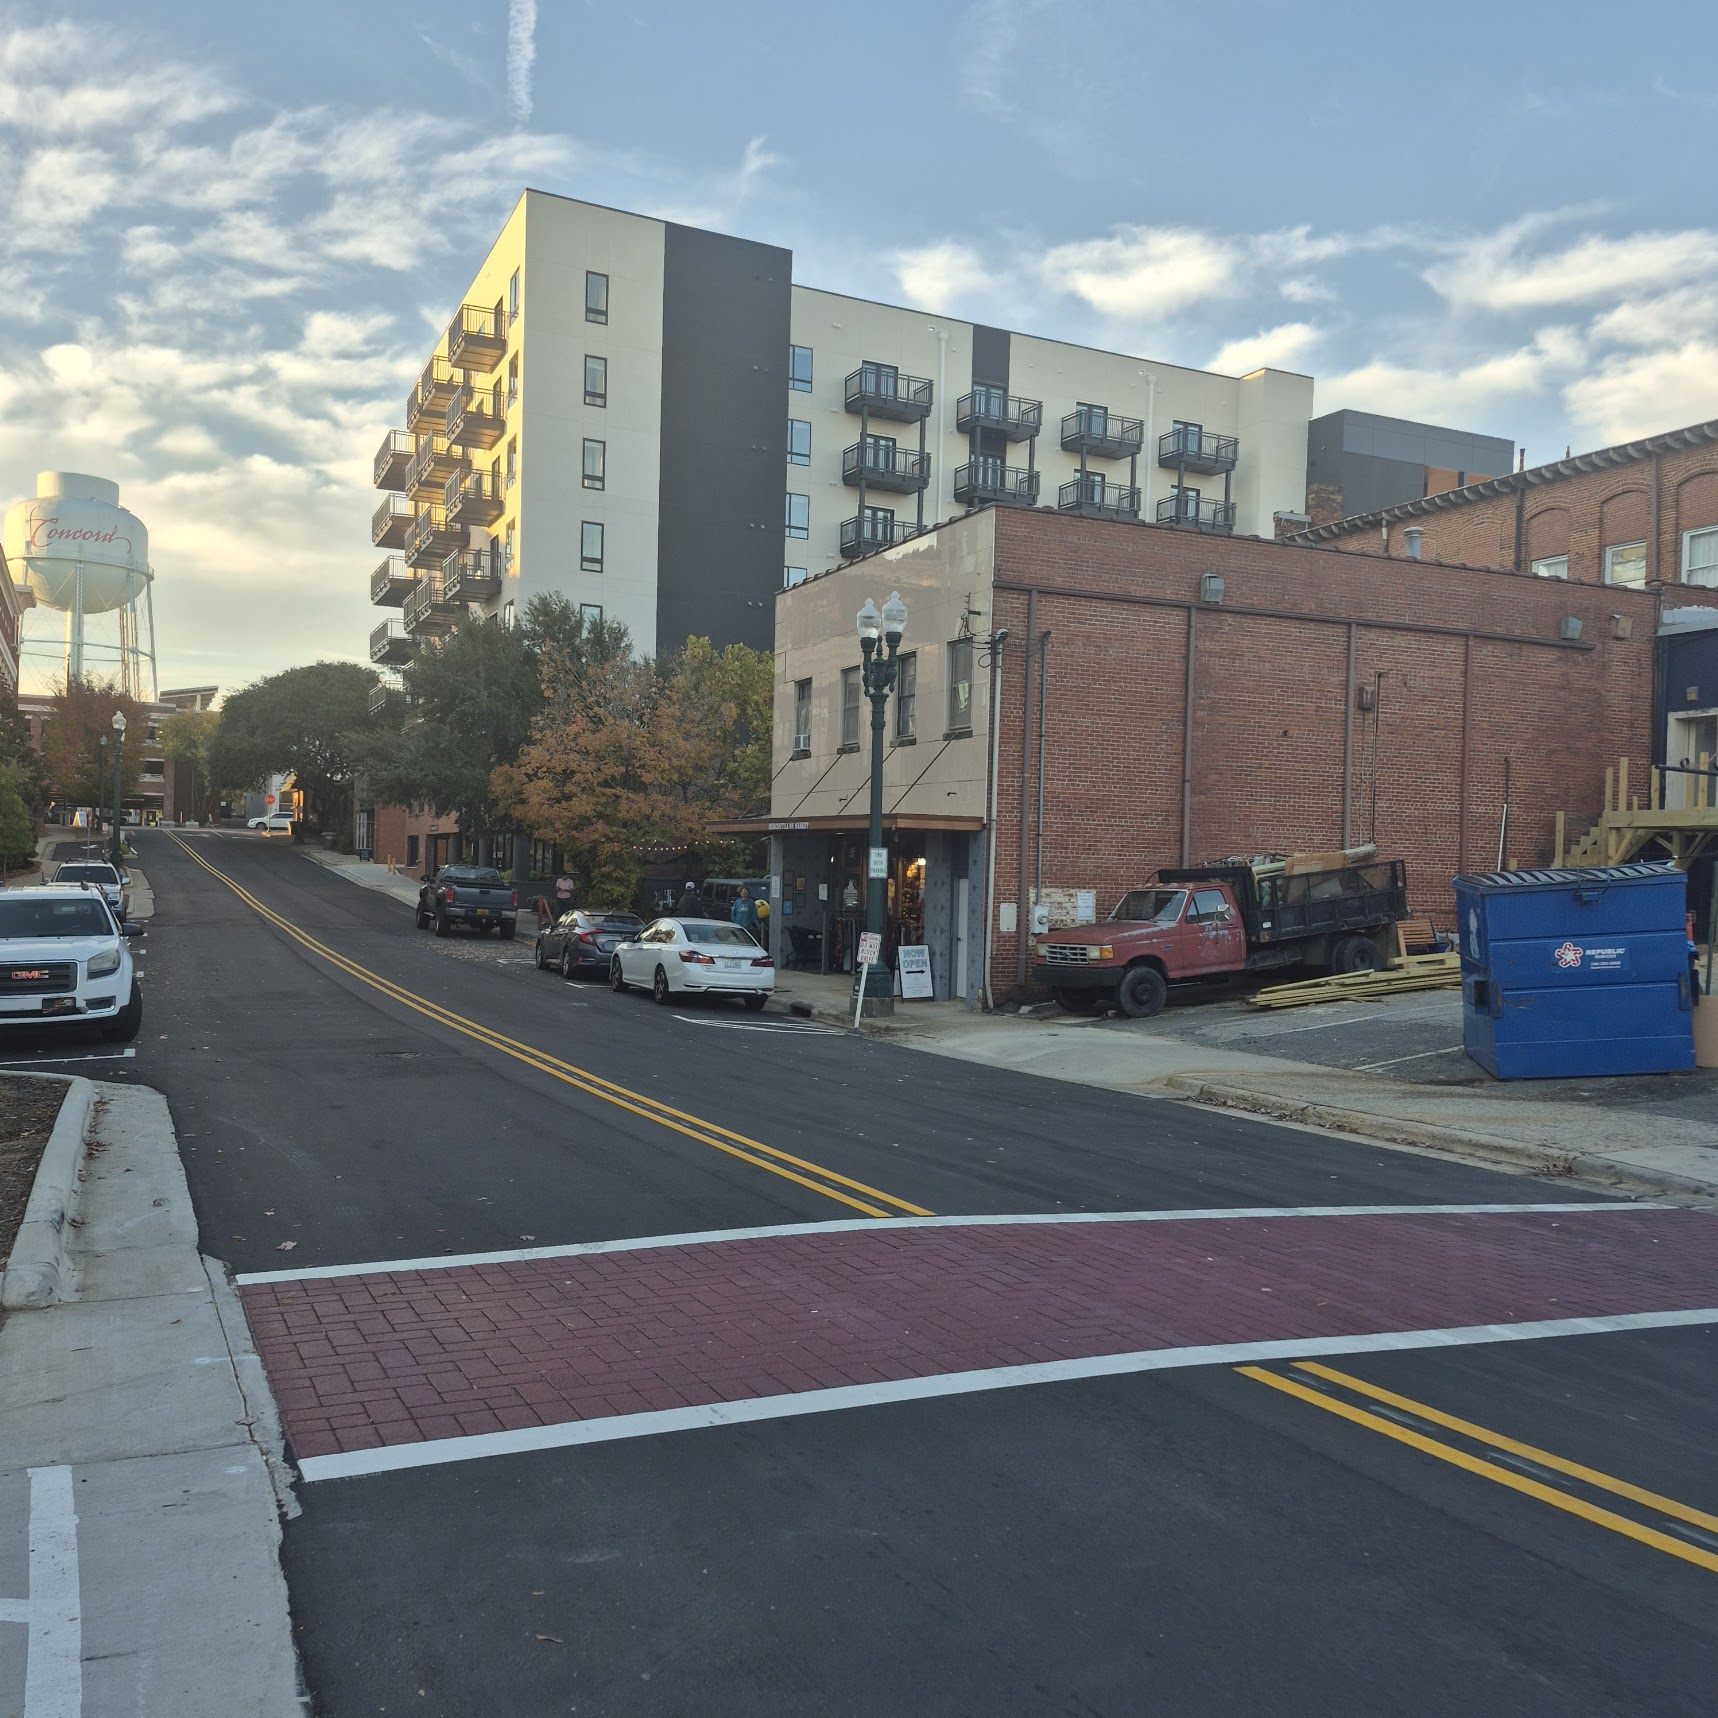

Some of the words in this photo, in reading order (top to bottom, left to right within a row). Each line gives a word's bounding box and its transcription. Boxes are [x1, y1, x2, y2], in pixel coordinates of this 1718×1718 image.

[26, 499, 132, 553] Concord
[903, 949, 925, 958] NOW
[1585, 948, 1625, 956] REPUBLIC
[902, 959, 928, 968] OPEN
[12, 969, 49, 979] GMC
